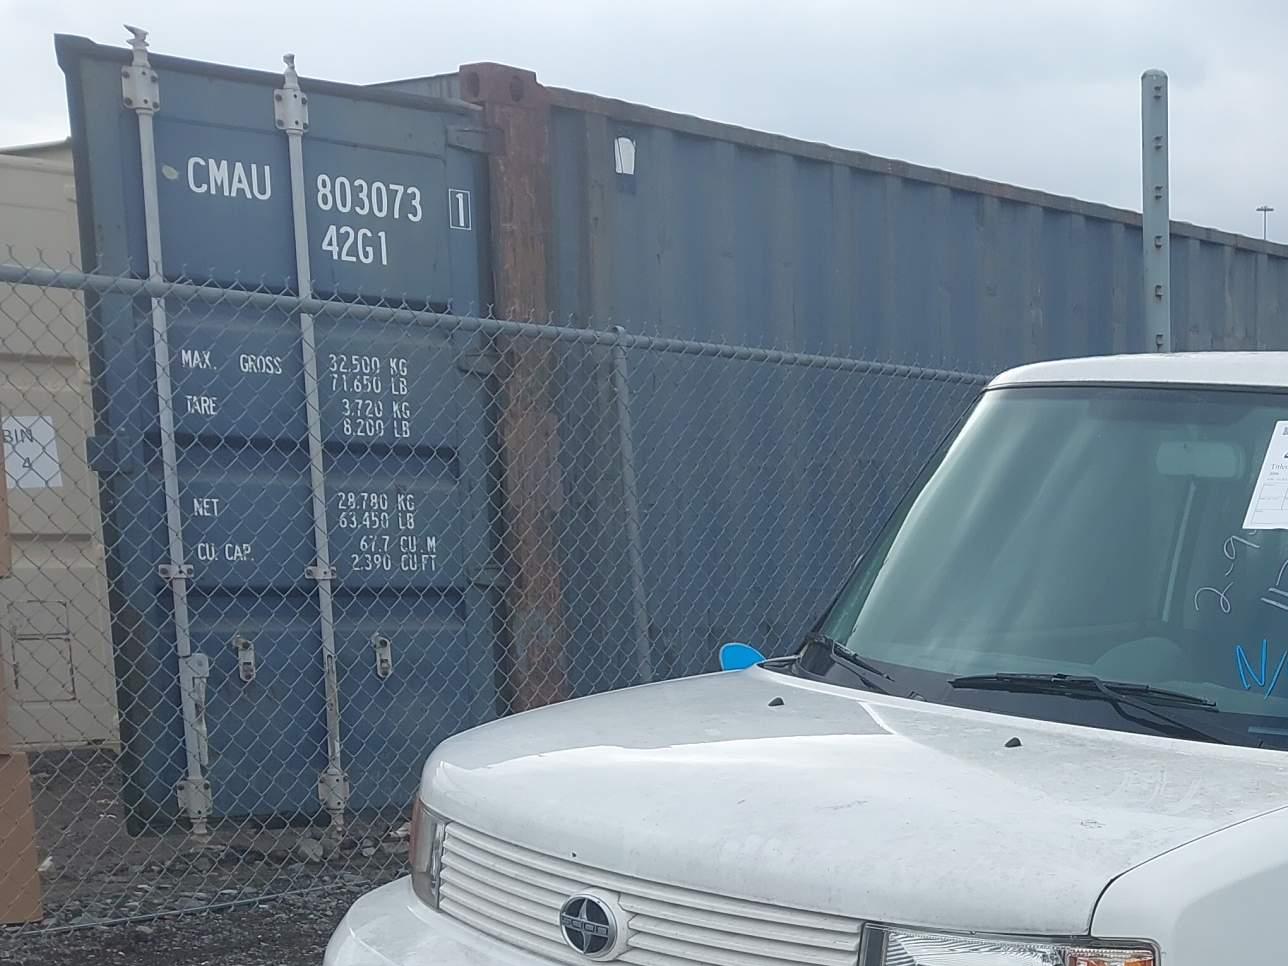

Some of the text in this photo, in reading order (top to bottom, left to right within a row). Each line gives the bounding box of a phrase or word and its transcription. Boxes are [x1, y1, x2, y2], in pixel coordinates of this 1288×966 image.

[187, 156, 271, 200] CMAU
[317, 173, 423, 222] 803073
[321, 224, 388, 265] 42G1
[181, 349, 408, 376] MAX. GROSS 32.500 KG
[330, 374, 408, 396] 71.650 LB
[184, 396, 411, 419] TARE 3.720 KG
[3, 428, 34, 443] BIN
[343, 418, 411, 438] 8.200 LB
[193, 492, 415, 517] NET 28.780 KG
[339, 511, 415, 530] 63.450 LB
[197, 542, 219, 561] CU.
[225, 543, 255, 562] CAP.
[360, 535, 390, 553] 67.7
[351, 554, 392, 571] 2.390
